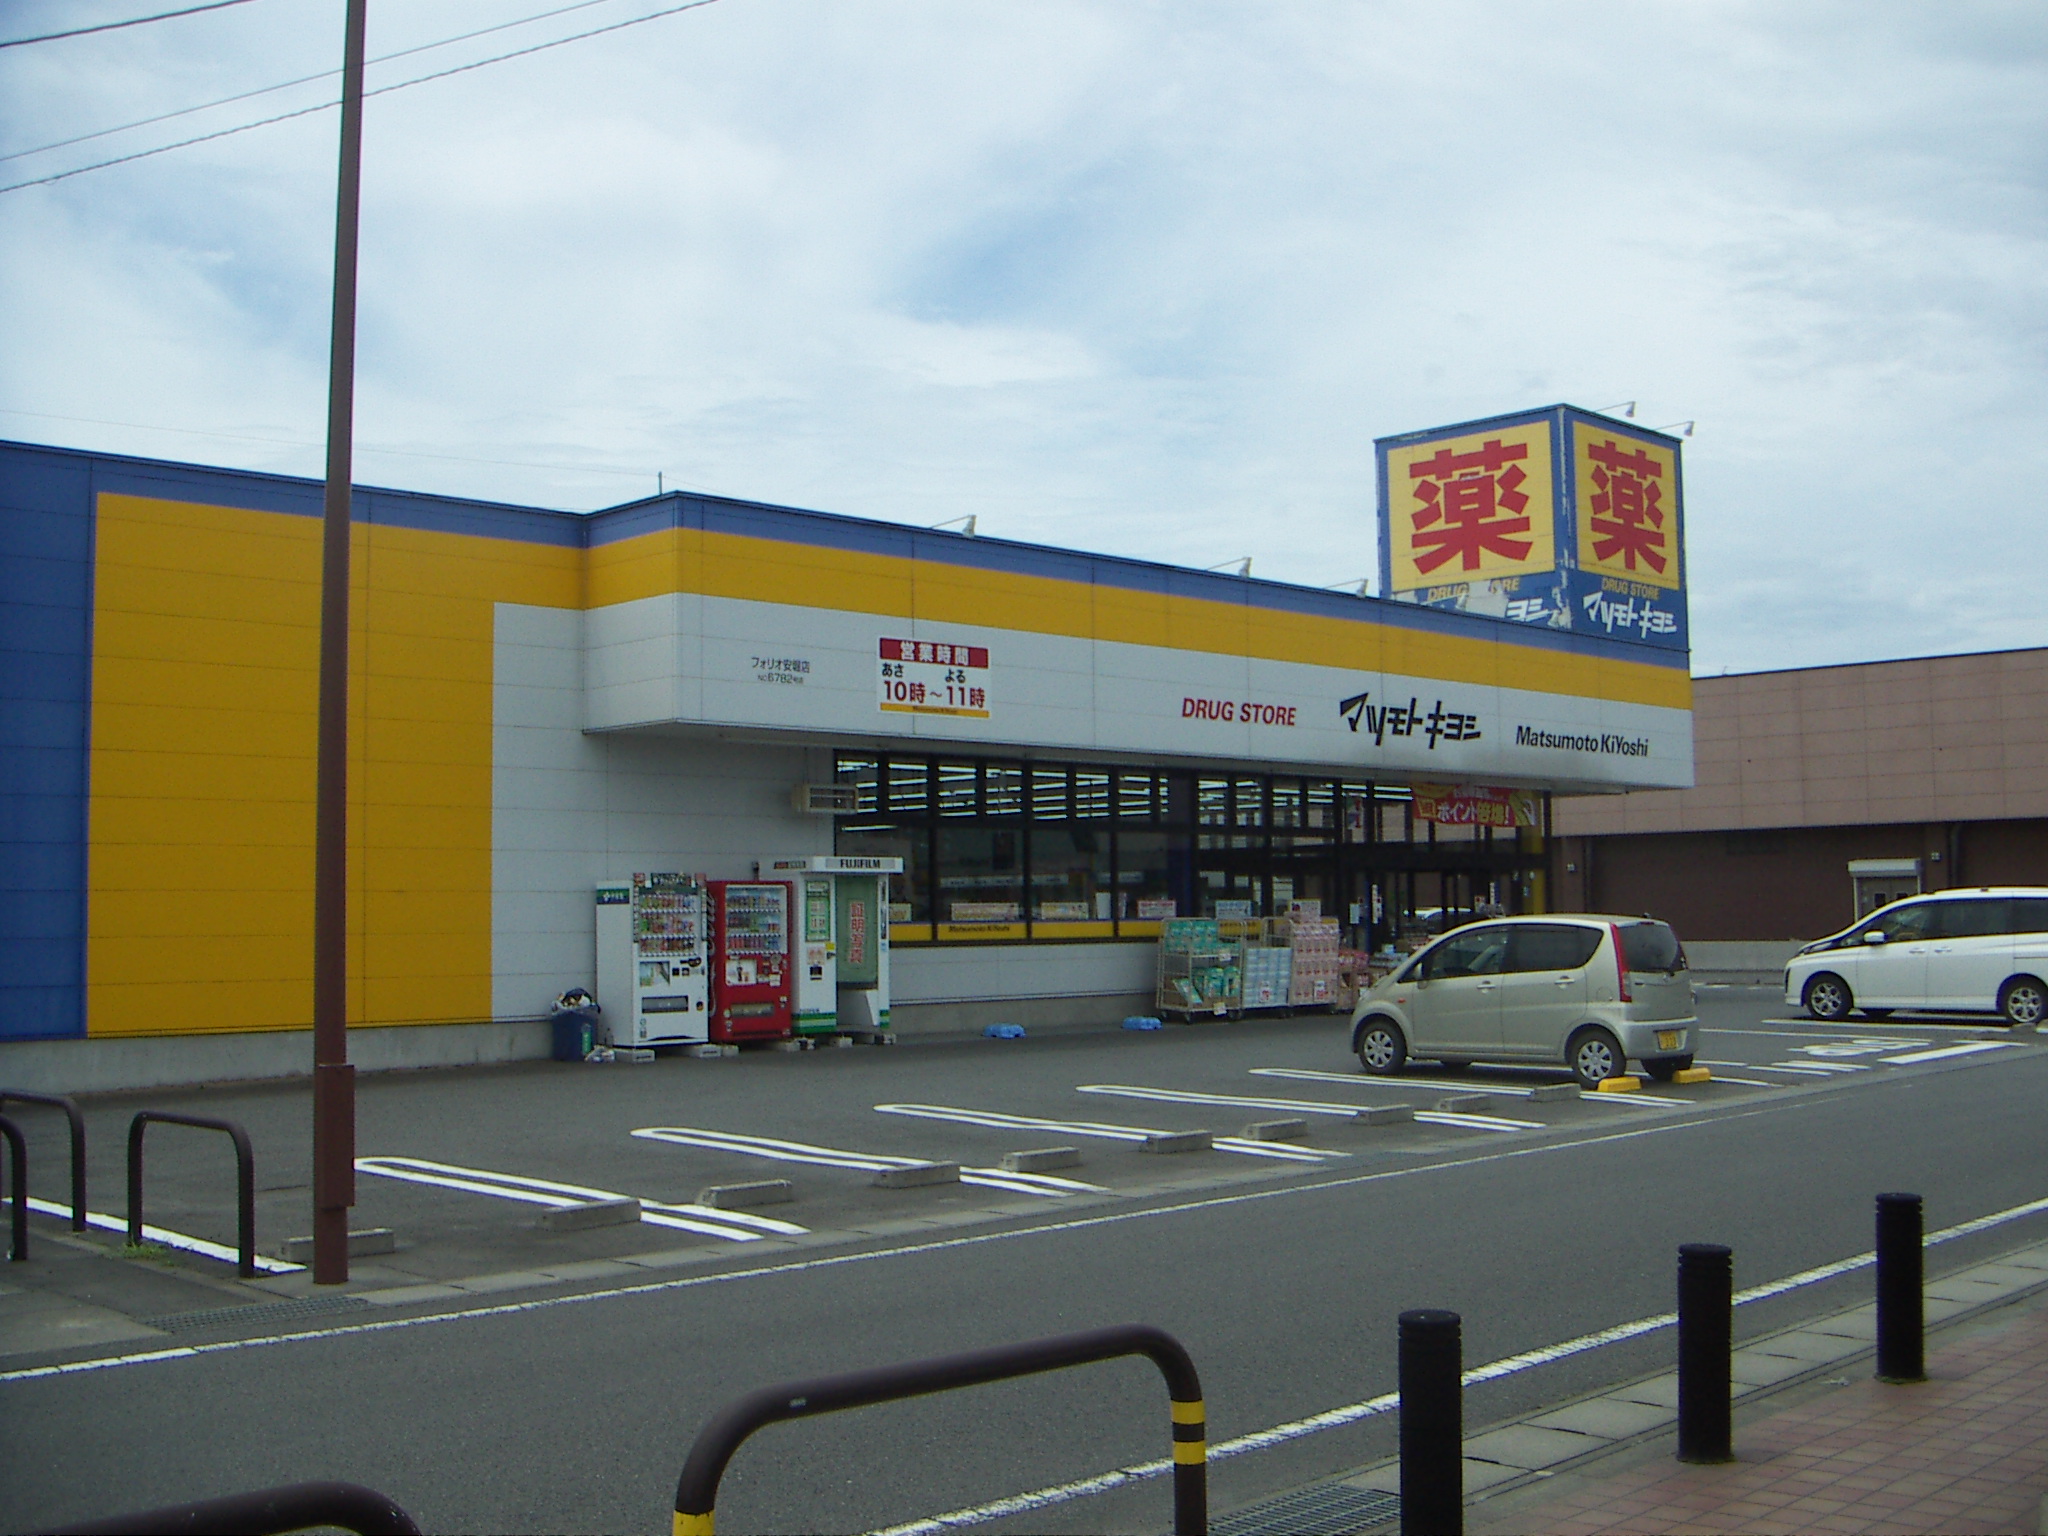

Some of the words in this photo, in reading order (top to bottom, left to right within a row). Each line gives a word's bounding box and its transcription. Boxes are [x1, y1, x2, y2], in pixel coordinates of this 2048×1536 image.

[1409, 438, 1533, 575] 薬
[1588, 439, 1667, 575] 薬
[1601, 577, 1629, 595] DRUG
[1630, 582, 1661, 601] STORE
[1582, 591, 1677, 640] マツモトキヨシ
[900, 640, 970, 666] 営業時間
[882, 662, 904, 679] あさ
[945, 667, 966, 684] よる
[1181, 697, 1235, 722] DRUG
[1240, 702, 1297, 726] STORE
[1339, 691, 1482, 750] マツモトキヨシ
[1515, 724, 1599, 753] Matsumoto
[1600, 733, 1649, 757] KiYoshi
[840, 858, 881, 869] FUJIFILM
